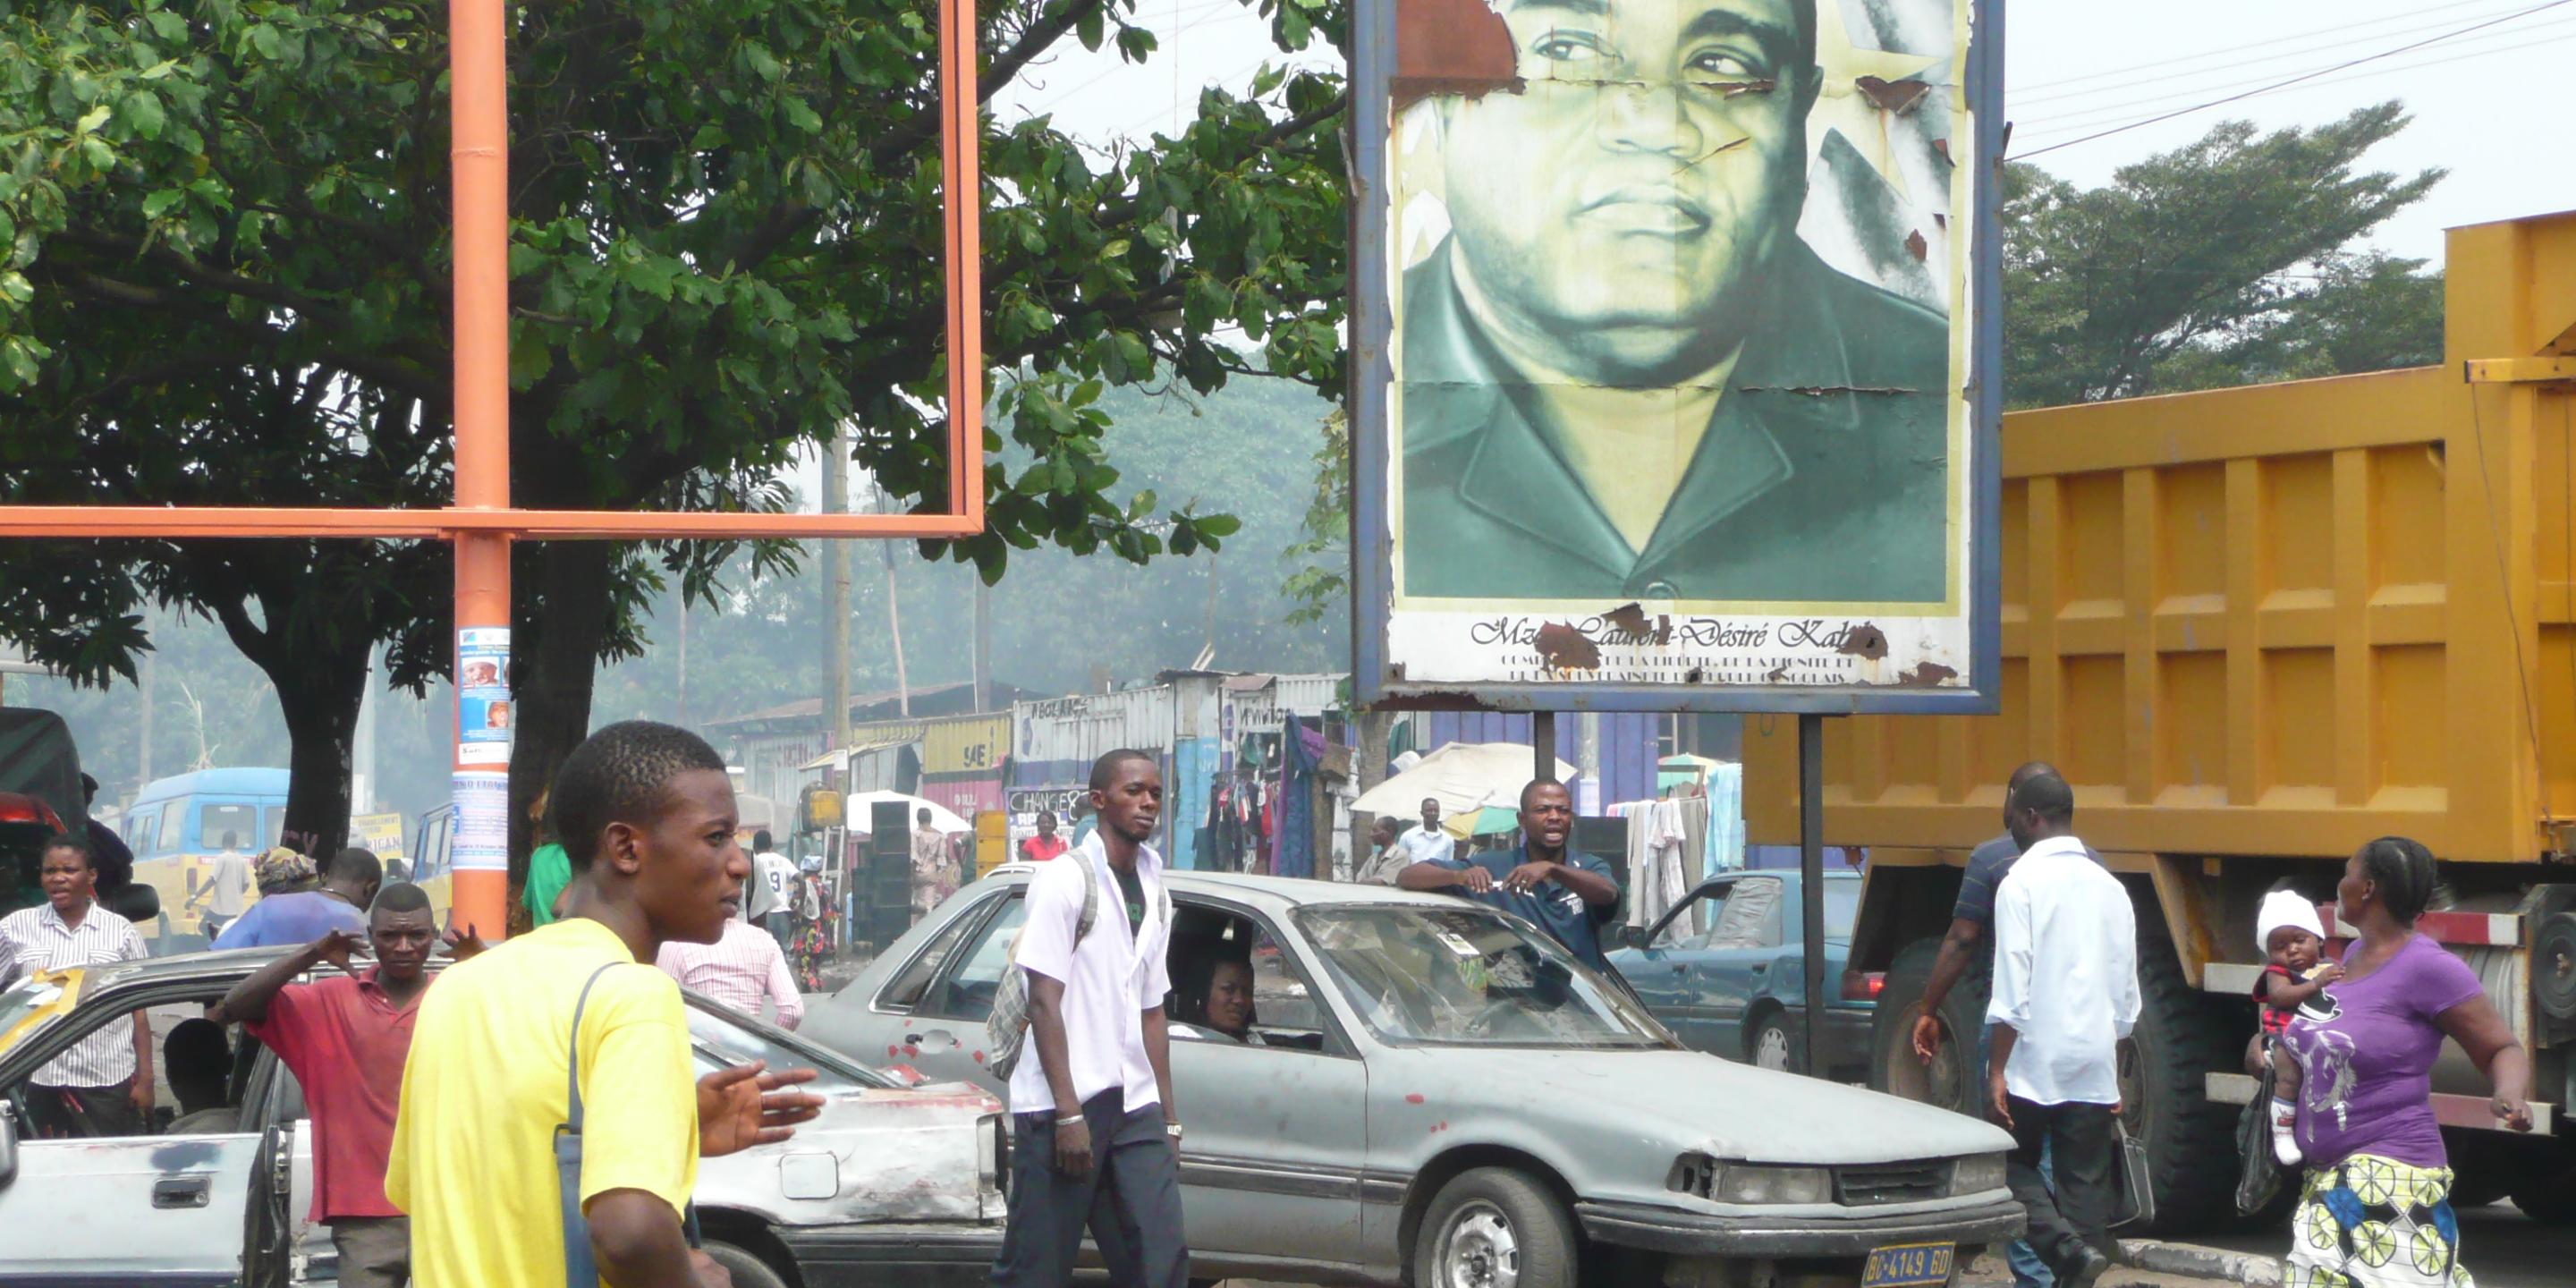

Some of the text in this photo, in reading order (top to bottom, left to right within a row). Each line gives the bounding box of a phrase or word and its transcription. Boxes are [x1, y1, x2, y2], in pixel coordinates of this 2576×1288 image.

[1778, 619, 1871, 648] Kab
[1760, 673, 1846, 683] CNGOLAIS
[770, 871, 781, 893] 9
